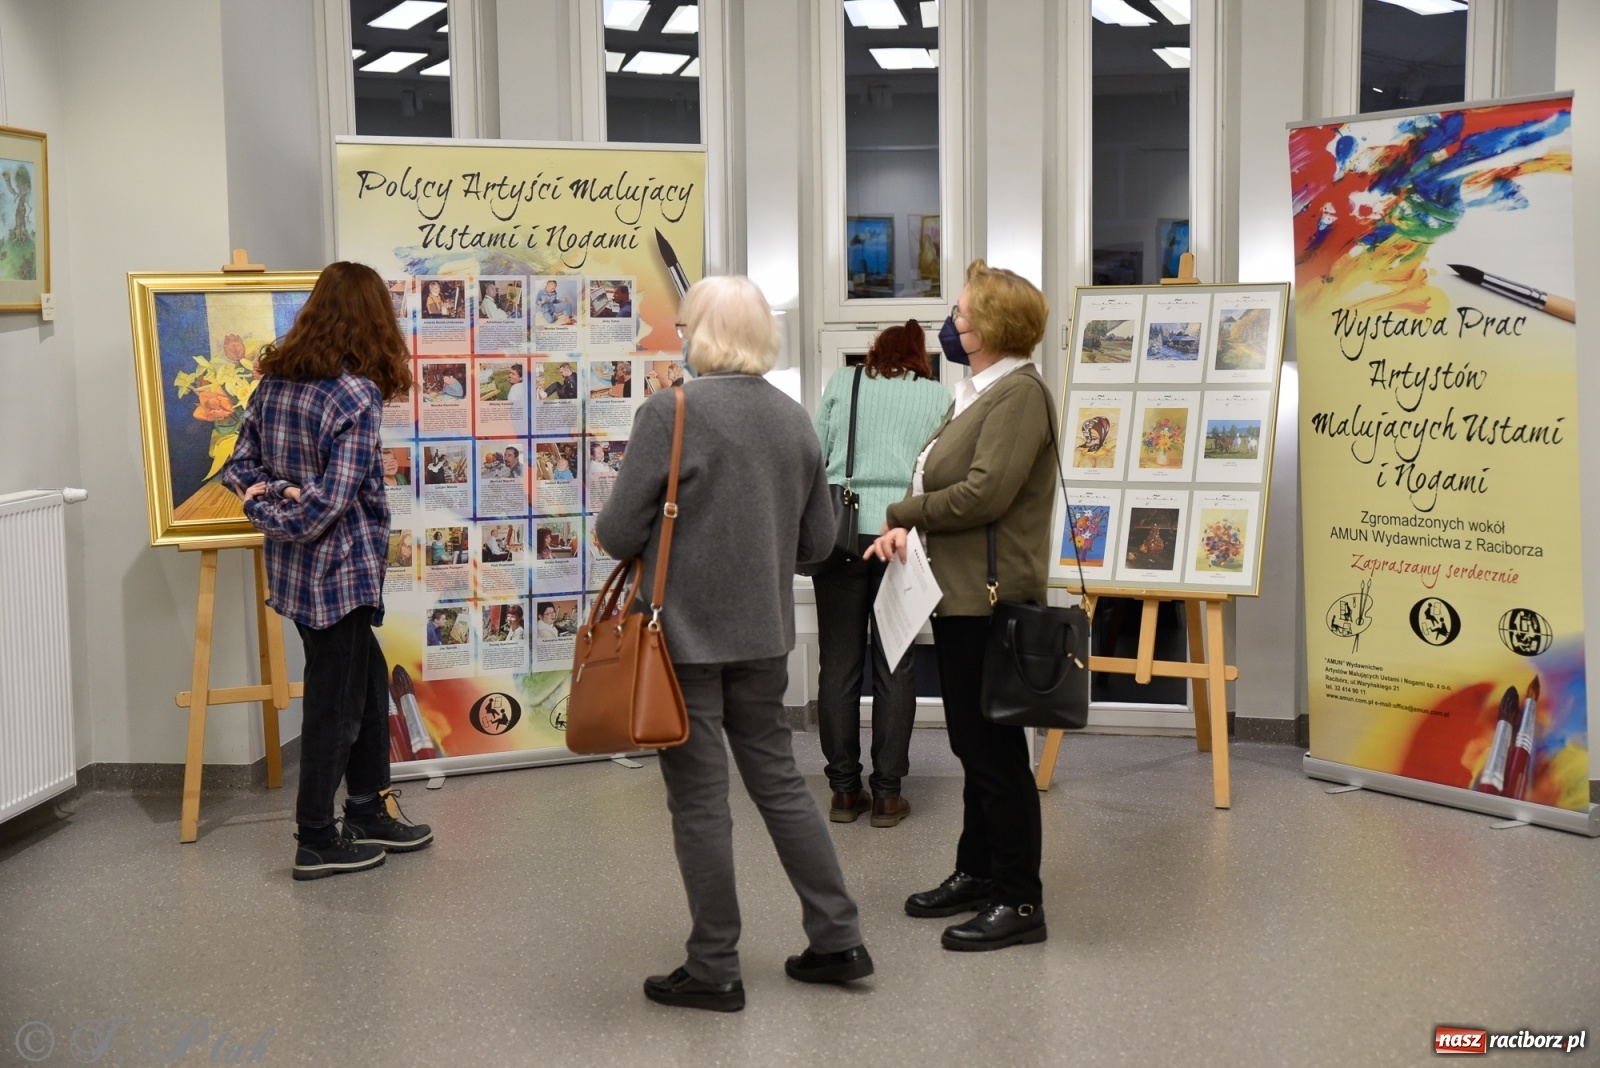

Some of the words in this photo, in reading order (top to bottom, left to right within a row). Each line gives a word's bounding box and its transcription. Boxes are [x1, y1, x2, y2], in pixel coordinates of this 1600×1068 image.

[357, 166, 453, 220] Polscy
[462, 172, 562, 221] Artyści
[418, 224, 519, 250] Ustami
[527, 226, 541, 249] i
[547, 224, 640, 269] Nogami
[1331, 307, 1448, 361] Wystawa
[1457, 306, 1527, 338] Prac
[1368, 358, 1488, 412] Artystów
[1311, 404, 1457, 464] Malujących
[1462, 414, 1565, 445] Ustami
[1376, 462, 1389, 488] i
[1394, 463, 1491, 513] Nogami
[1330, 526, 1368, 542] AMUN
[1372, 530, 1461, 550] Wydawnictwa
[1465, 540, 1473, 550] z
[1476, 538, 1544, 557] Raciborza
[1360, 511, 1464, 533] Zgromadzonych
[1468, 521, 1505, 535] wokół
[1351, 553, 1441, 589] Zapraszamy
[1446, 564, 1519, 584] serdecznie
[1325, 666, 1348, 675] Artystów
[1380, 674, 1400, 683] Ustami
[1404, 678, 1425, 687] Nogami
[1346, 660, 1383, 672] Wydawnictwo
[1326, 692, 1374, 706] www.amun.com.pl
